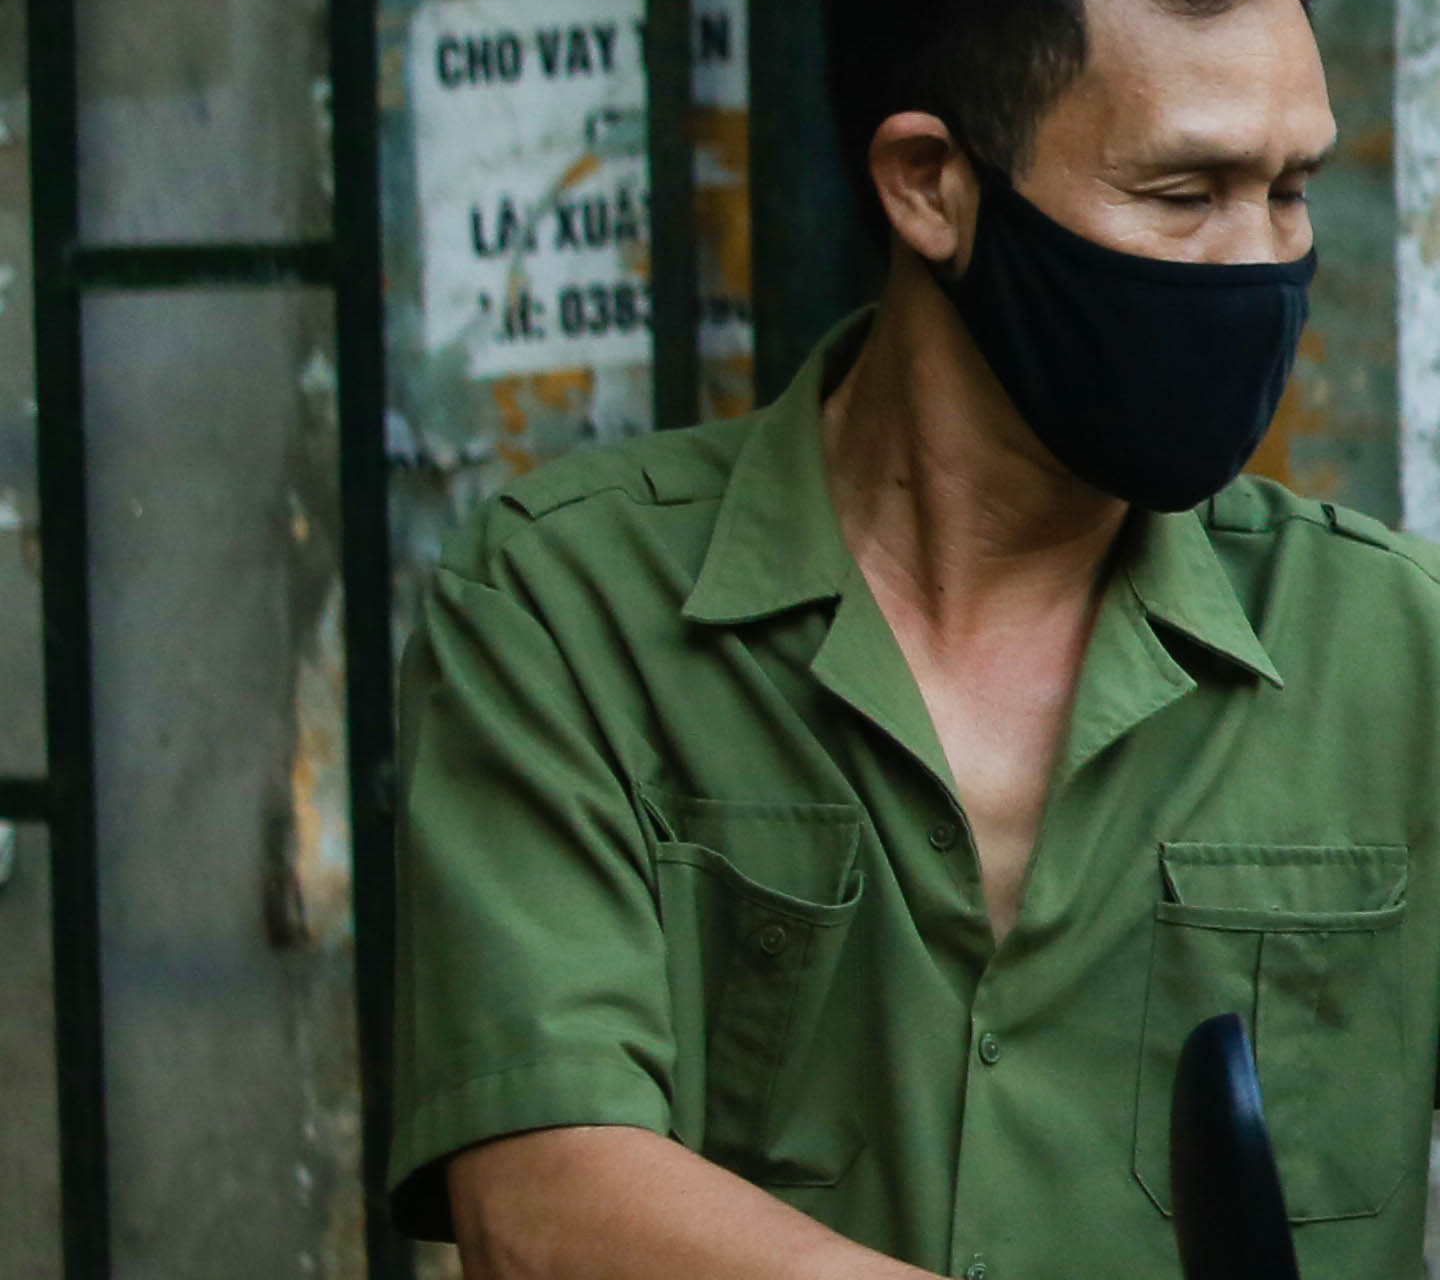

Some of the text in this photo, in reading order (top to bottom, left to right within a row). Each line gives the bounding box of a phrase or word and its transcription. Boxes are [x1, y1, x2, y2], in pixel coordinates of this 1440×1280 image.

[435, 31, 523, 92] CHO
[535, 23, 617, 81] VAY
[558, 282, 652, 339] 038
